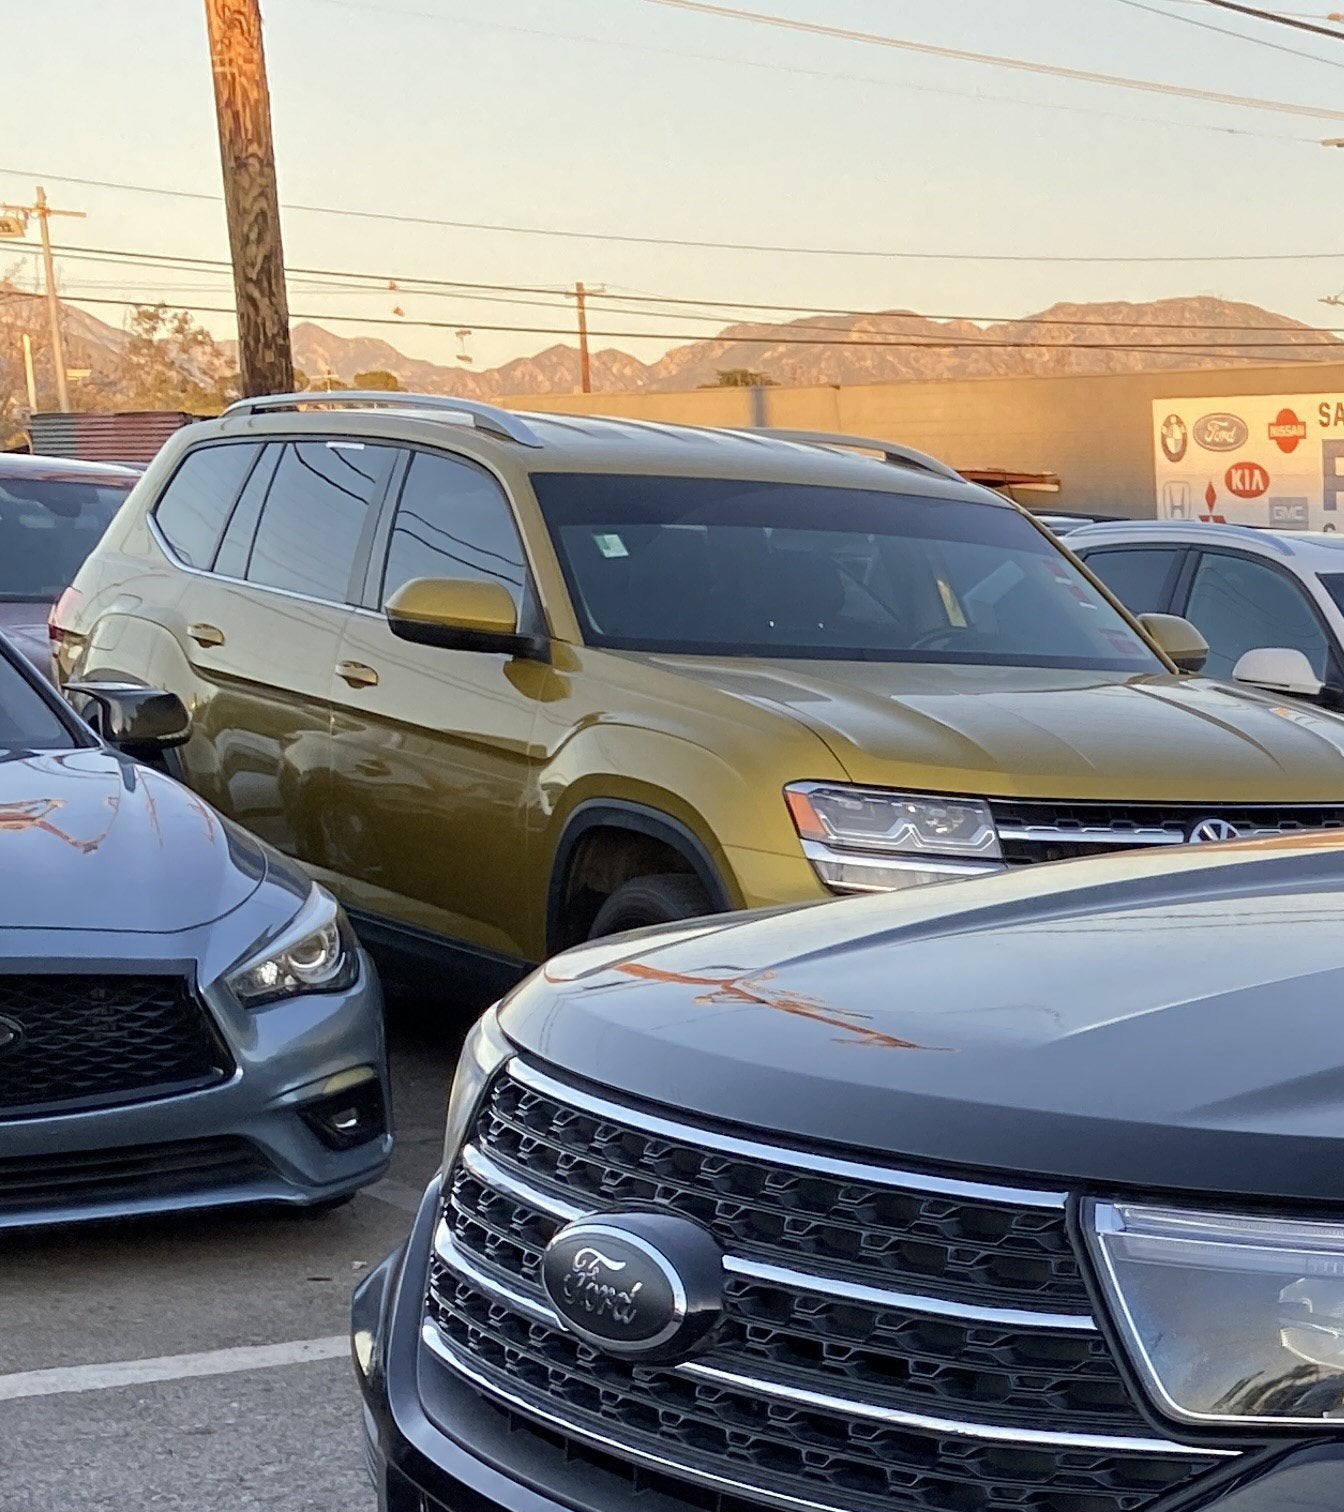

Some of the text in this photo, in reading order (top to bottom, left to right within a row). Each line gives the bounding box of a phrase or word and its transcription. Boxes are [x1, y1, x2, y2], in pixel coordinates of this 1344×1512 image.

[1204, 420, 1236, 443] Ford
[1231, 469, 1265, 491] KIA
[1273, 505, 1303, 520] GMC
[563, 1247, 643, 1324] Ford
